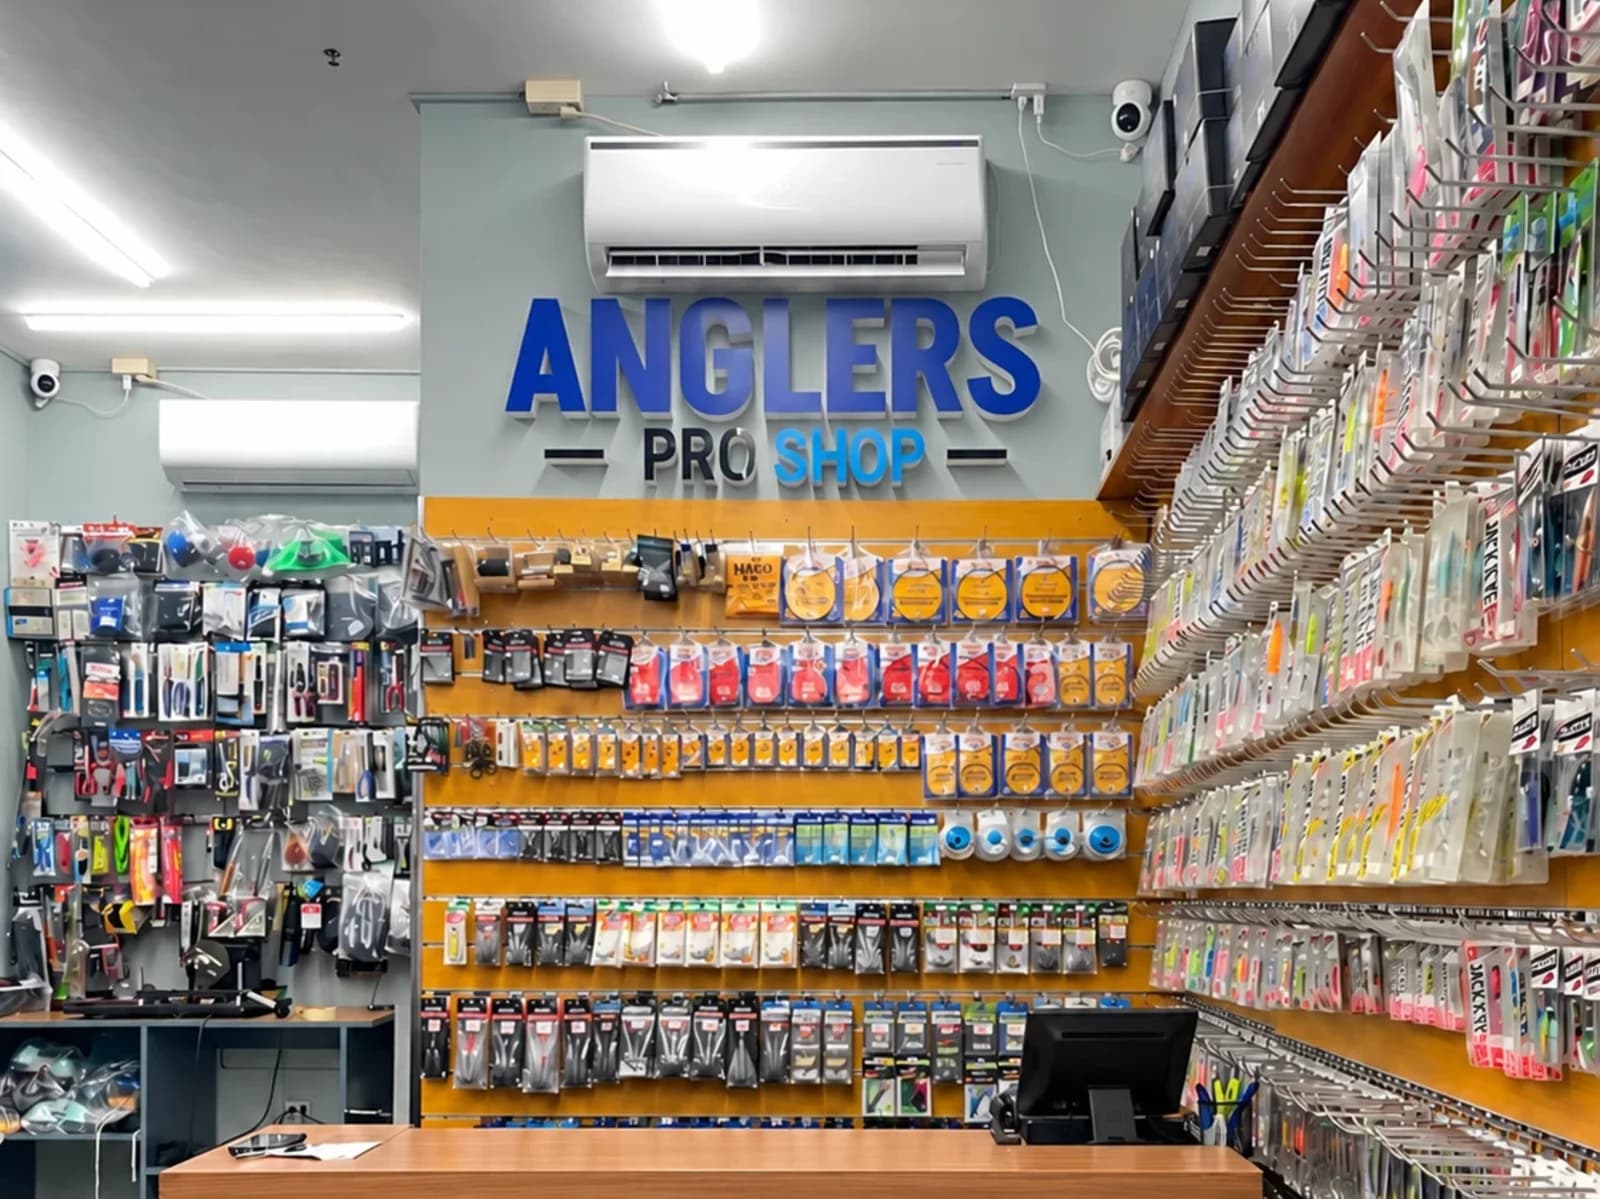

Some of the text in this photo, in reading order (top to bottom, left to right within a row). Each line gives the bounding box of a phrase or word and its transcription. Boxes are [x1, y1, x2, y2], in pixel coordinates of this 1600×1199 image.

[506, 297, 1041, 416] ANGLERS
[644, 428, 925, 484] PRO SHOP
